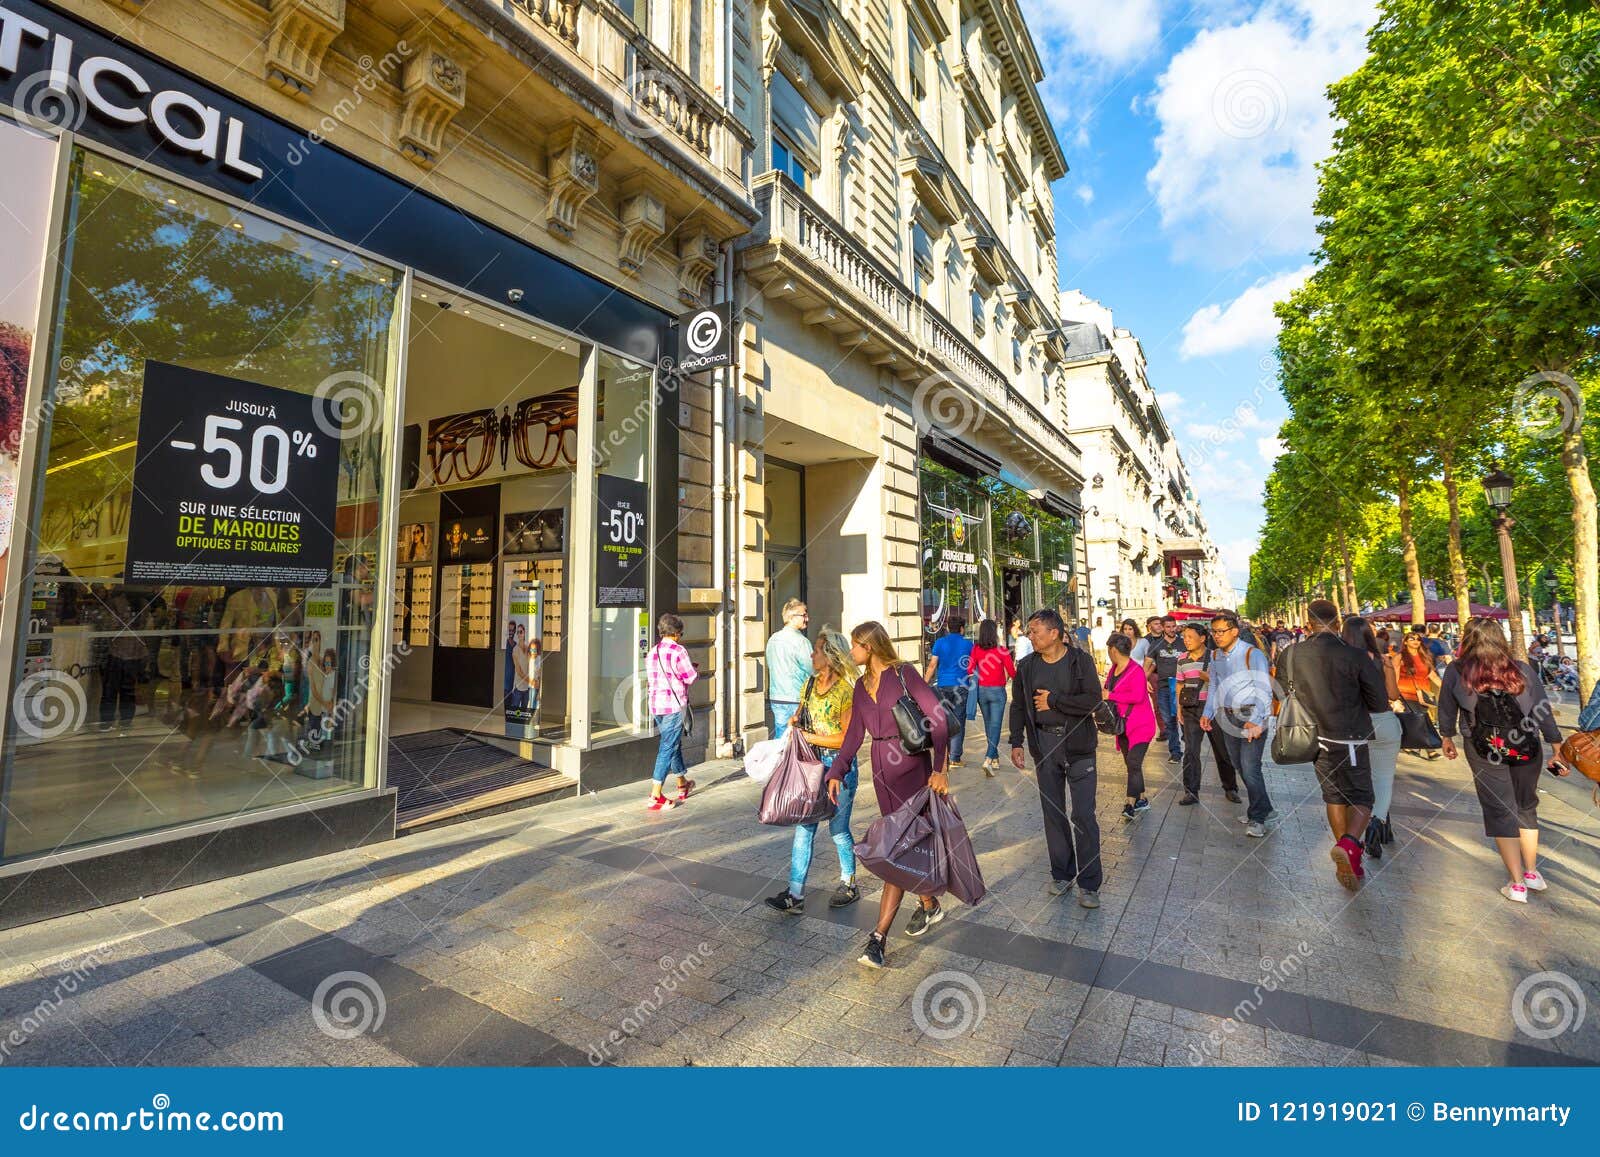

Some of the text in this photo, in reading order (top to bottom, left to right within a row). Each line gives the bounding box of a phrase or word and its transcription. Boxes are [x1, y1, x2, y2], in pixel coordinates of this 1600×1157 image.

[225, 400, 277, 419] JUSQU'À
[170, 414, 317, 494] -50%
[179, 502, 301, 523] SUR UNE SÉLECTION
[178, 516, 301, 541] DE MARQUES
[601, 509, 644, 544] -50%
[176, 536, 231, 550] OPTIQUES
[234, 539, 247, 551] ET
[939, 560, 950, 572] CAR
